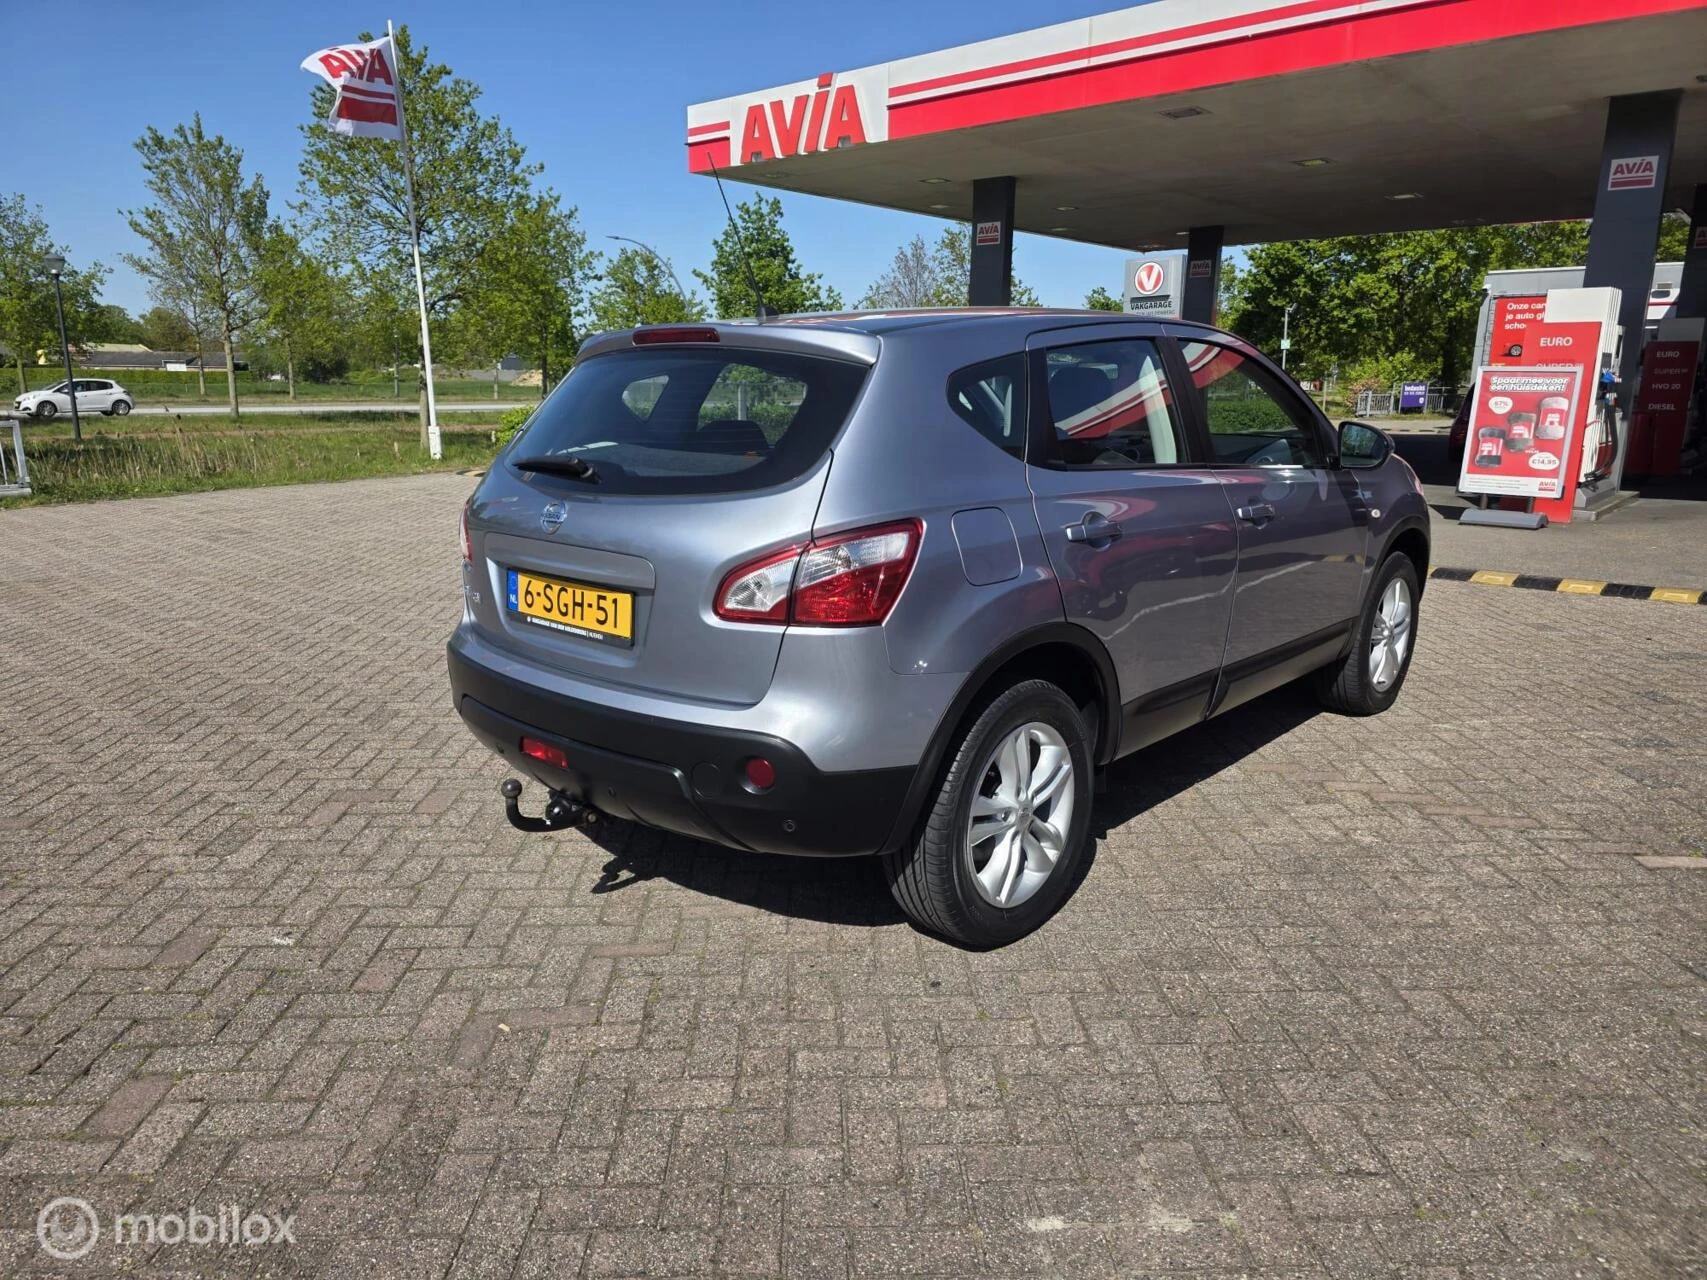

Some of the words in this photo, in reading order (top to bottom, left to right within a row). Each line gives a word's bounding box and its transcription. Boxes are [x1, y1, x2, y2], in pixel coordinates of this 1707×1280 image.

[1130, 300, 1172, 311] VAKGARAGE
[1507, 302, 1529, 311] Onze
[1505, 313, 1514, 321] je
[1540, 336, 1573, 347] EURO
[1492, 376, 1520, 385] Spaar
[1648, 403, 1676, 411] DIESEL
[509, 594, 518, 604] NL
[524, 580, 618, 629] 6-SGH-51
